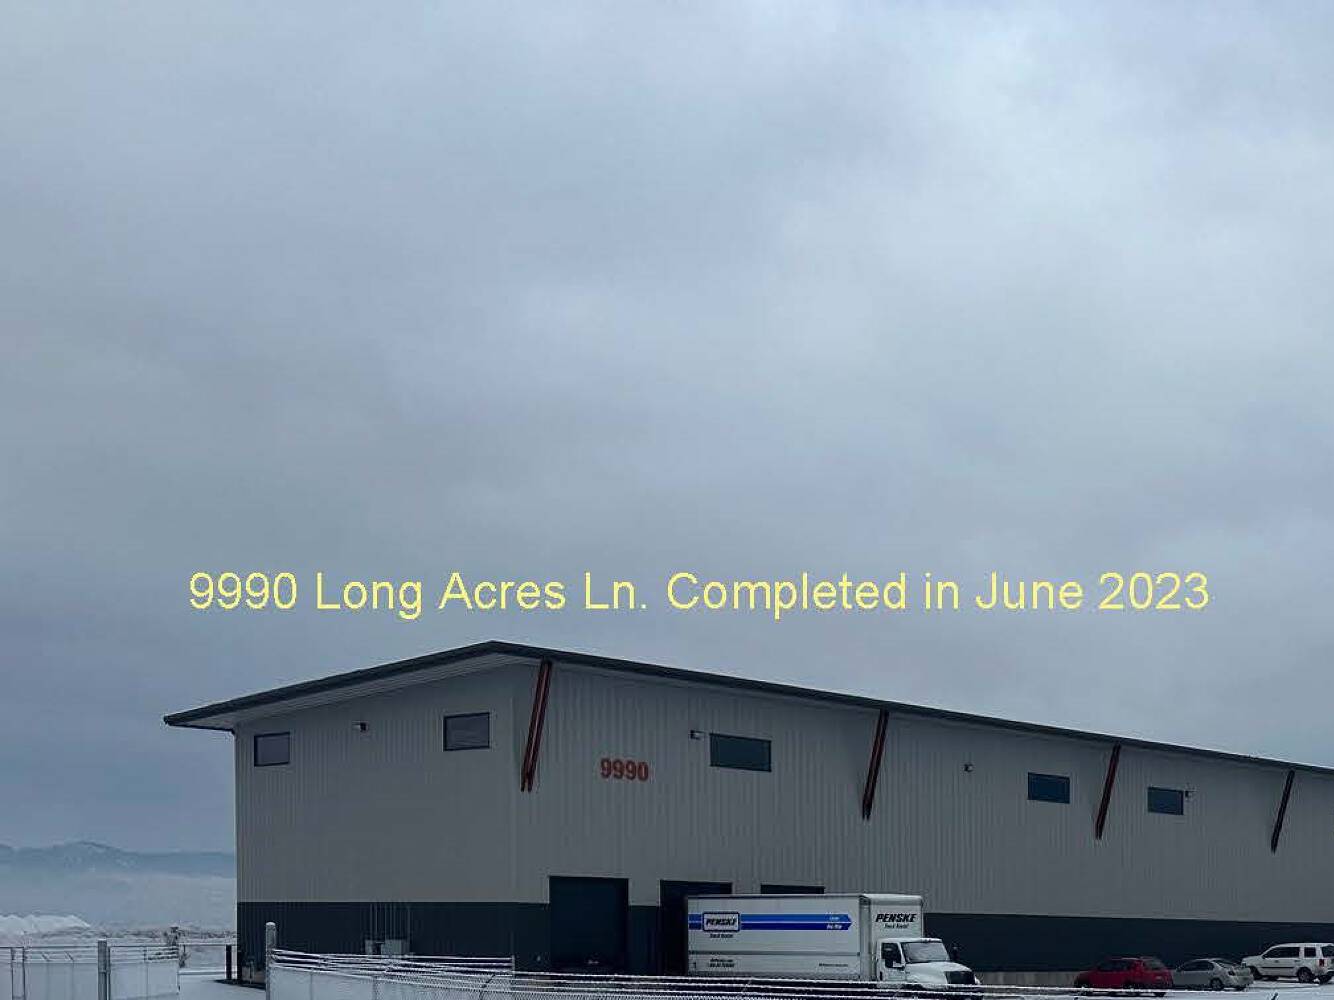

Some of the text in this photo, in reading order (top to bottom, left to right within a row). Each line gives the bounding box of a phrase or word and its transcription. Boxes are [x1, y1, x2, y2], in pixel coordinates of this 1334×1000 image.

[600, 758, 649, 781] 9990
[705, 918, 737, 926] PENSKE
[875, 913, 917, 923] PENSKE
